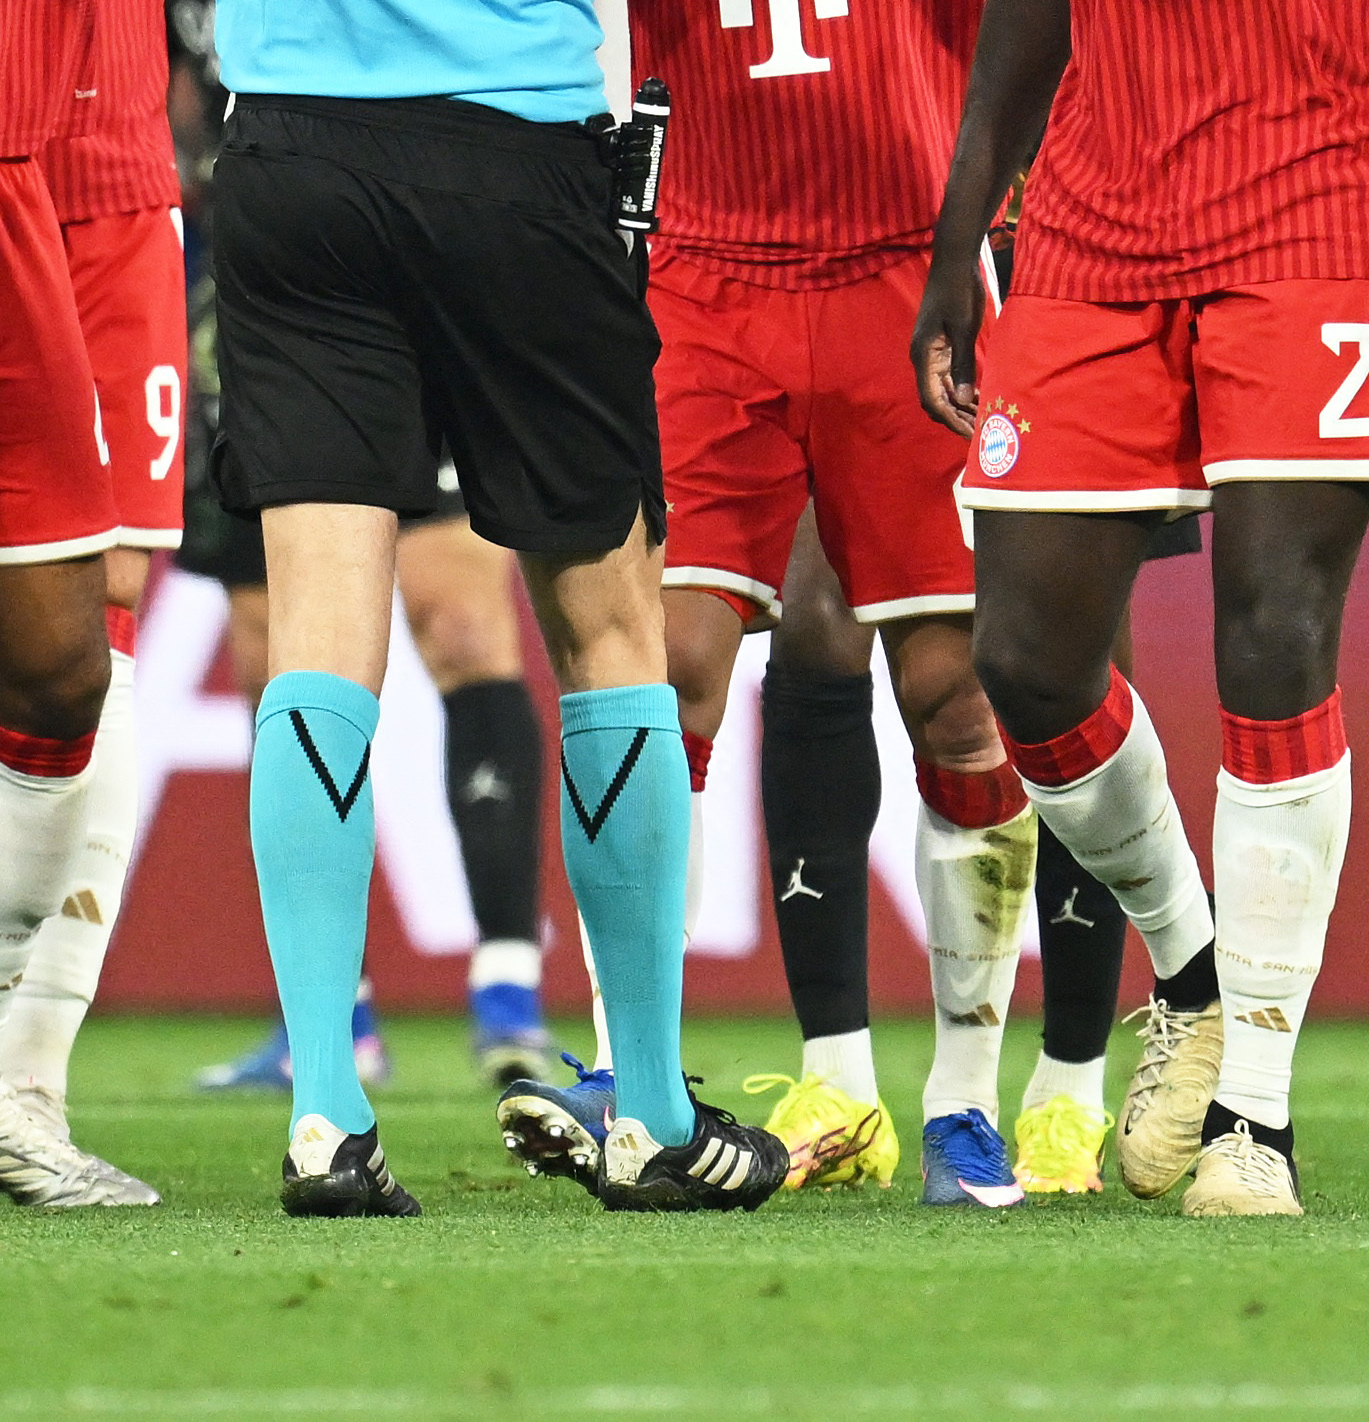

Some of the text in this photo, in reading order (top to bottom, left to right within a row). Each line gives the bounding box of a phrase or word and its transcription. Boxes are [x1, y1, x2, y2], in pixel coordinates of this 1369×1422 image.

[144, 365, 181, 481] 9
[1226, 951, 1252, 967] MIA
[1262, 961, 1296, 974] SAN
